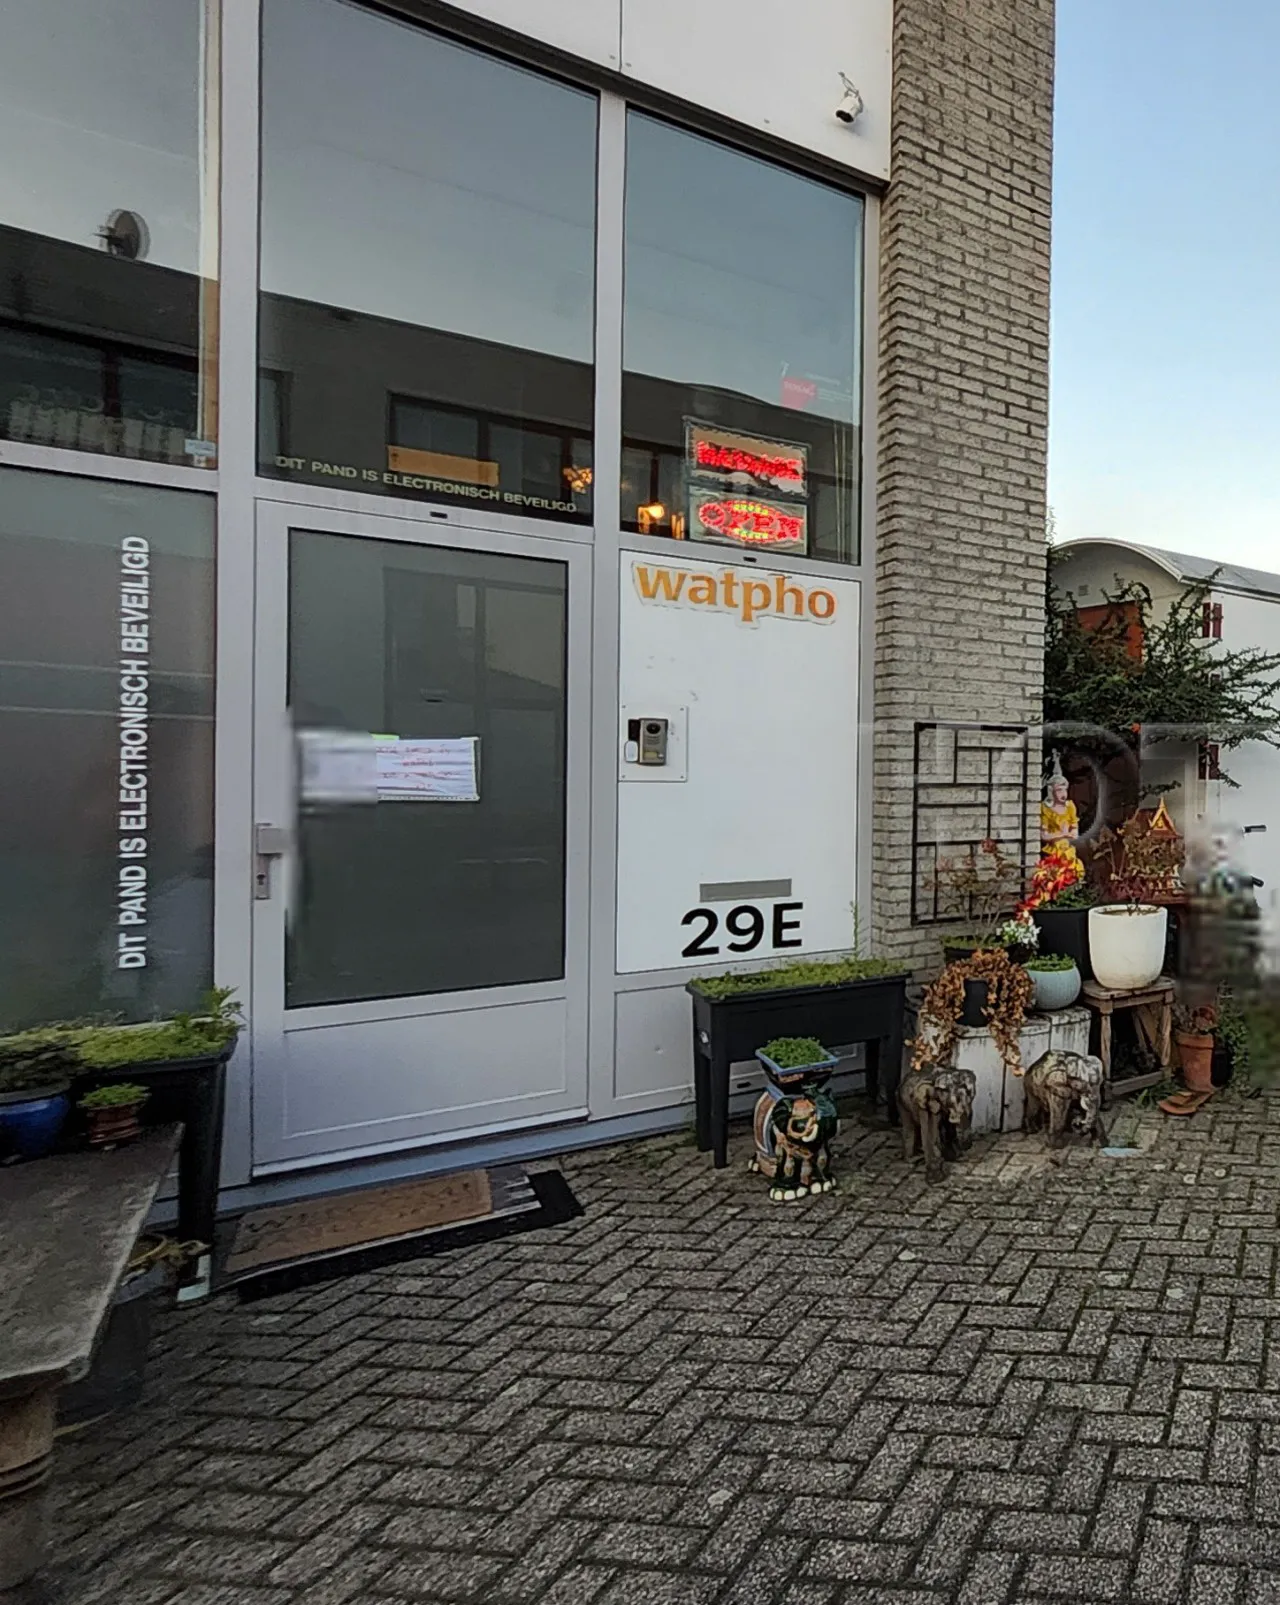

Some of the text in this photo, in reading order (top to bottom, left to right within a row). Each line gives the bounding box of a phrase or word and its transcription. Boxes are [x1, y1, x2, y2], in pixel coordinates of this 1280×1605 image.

[276, 455, 577, 514] DIT PAND IS ELECTRONISCH BEVEILIGD
[699, 501, 804, 542] OPEN
[636, 566, 836, 622] watpho
[118, 536, 150, 969] DIT PAND IS ELECTRONISCH BEVEILIGD
[681, 902, 804, 958] 29E
